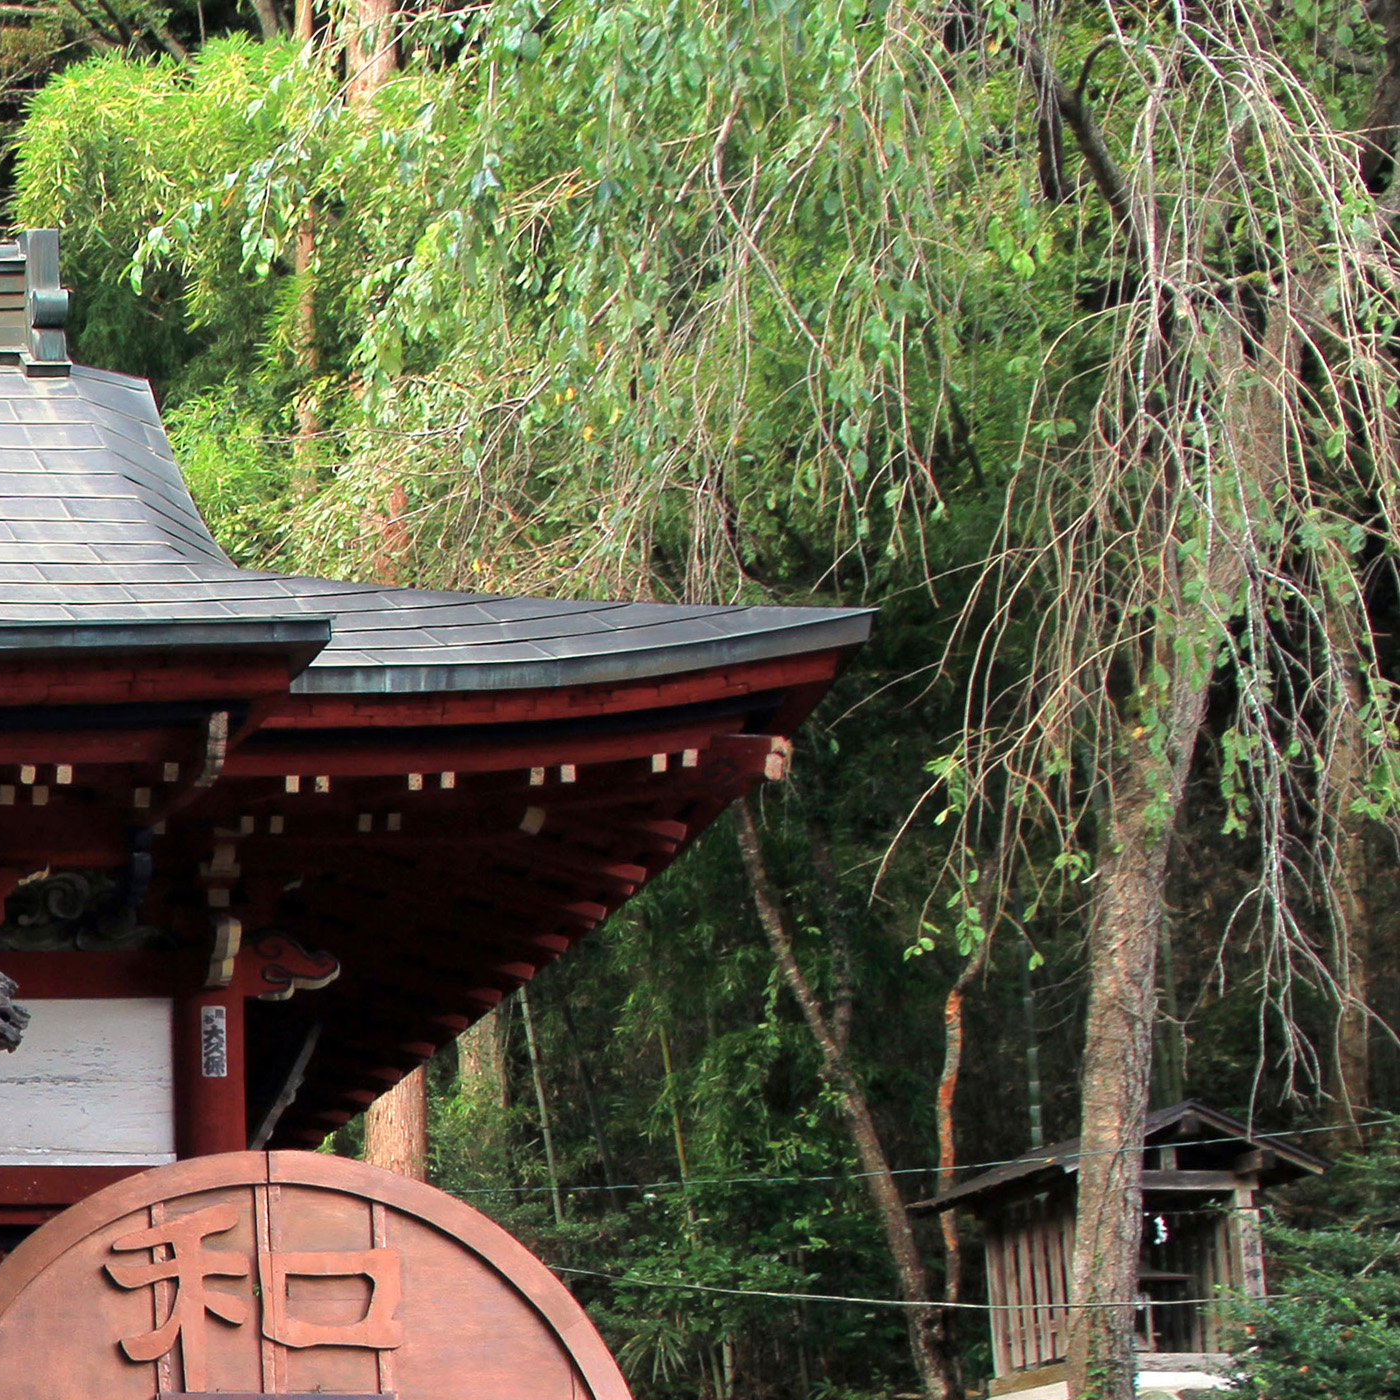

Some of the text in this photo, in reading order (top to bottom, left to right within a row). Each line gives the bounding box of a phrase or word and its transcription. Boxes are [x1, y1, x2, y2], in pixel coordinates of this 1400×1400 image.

[204, 1025, 225, 1075] 大久保
[106, 1203, 401, 1395] 和
